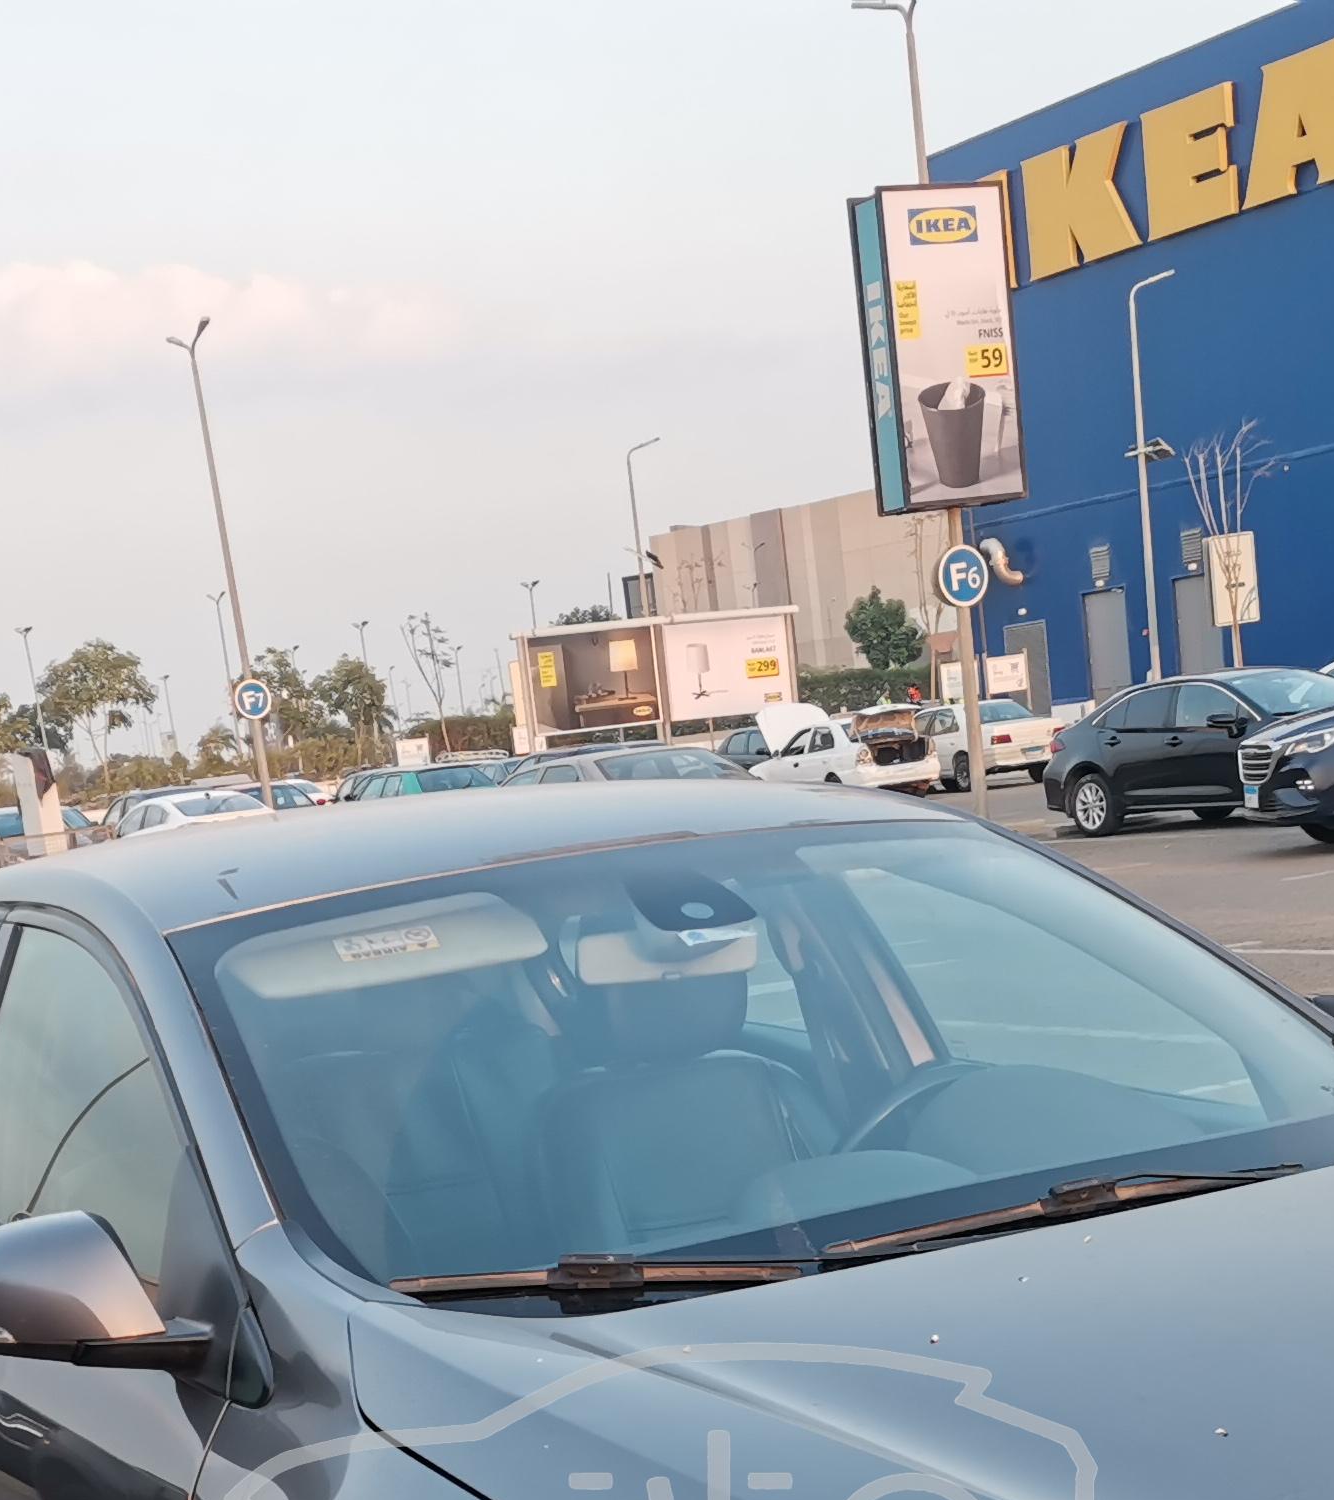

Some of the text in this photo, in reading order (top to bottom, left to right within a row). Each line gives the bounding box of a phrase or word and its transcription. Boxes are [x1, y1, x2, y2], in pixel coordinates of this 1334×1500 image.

[915, 217, 971, 233] IKEA
[978, 327, 1003, 338] FNISS
[866, 280, 892, 421] IKEA
[981, 348, 1003, 369] 59
[950, 561, 981, 592] F6
[756, 659, 777, 672] 299
[242, 690, 264, 710] F7
